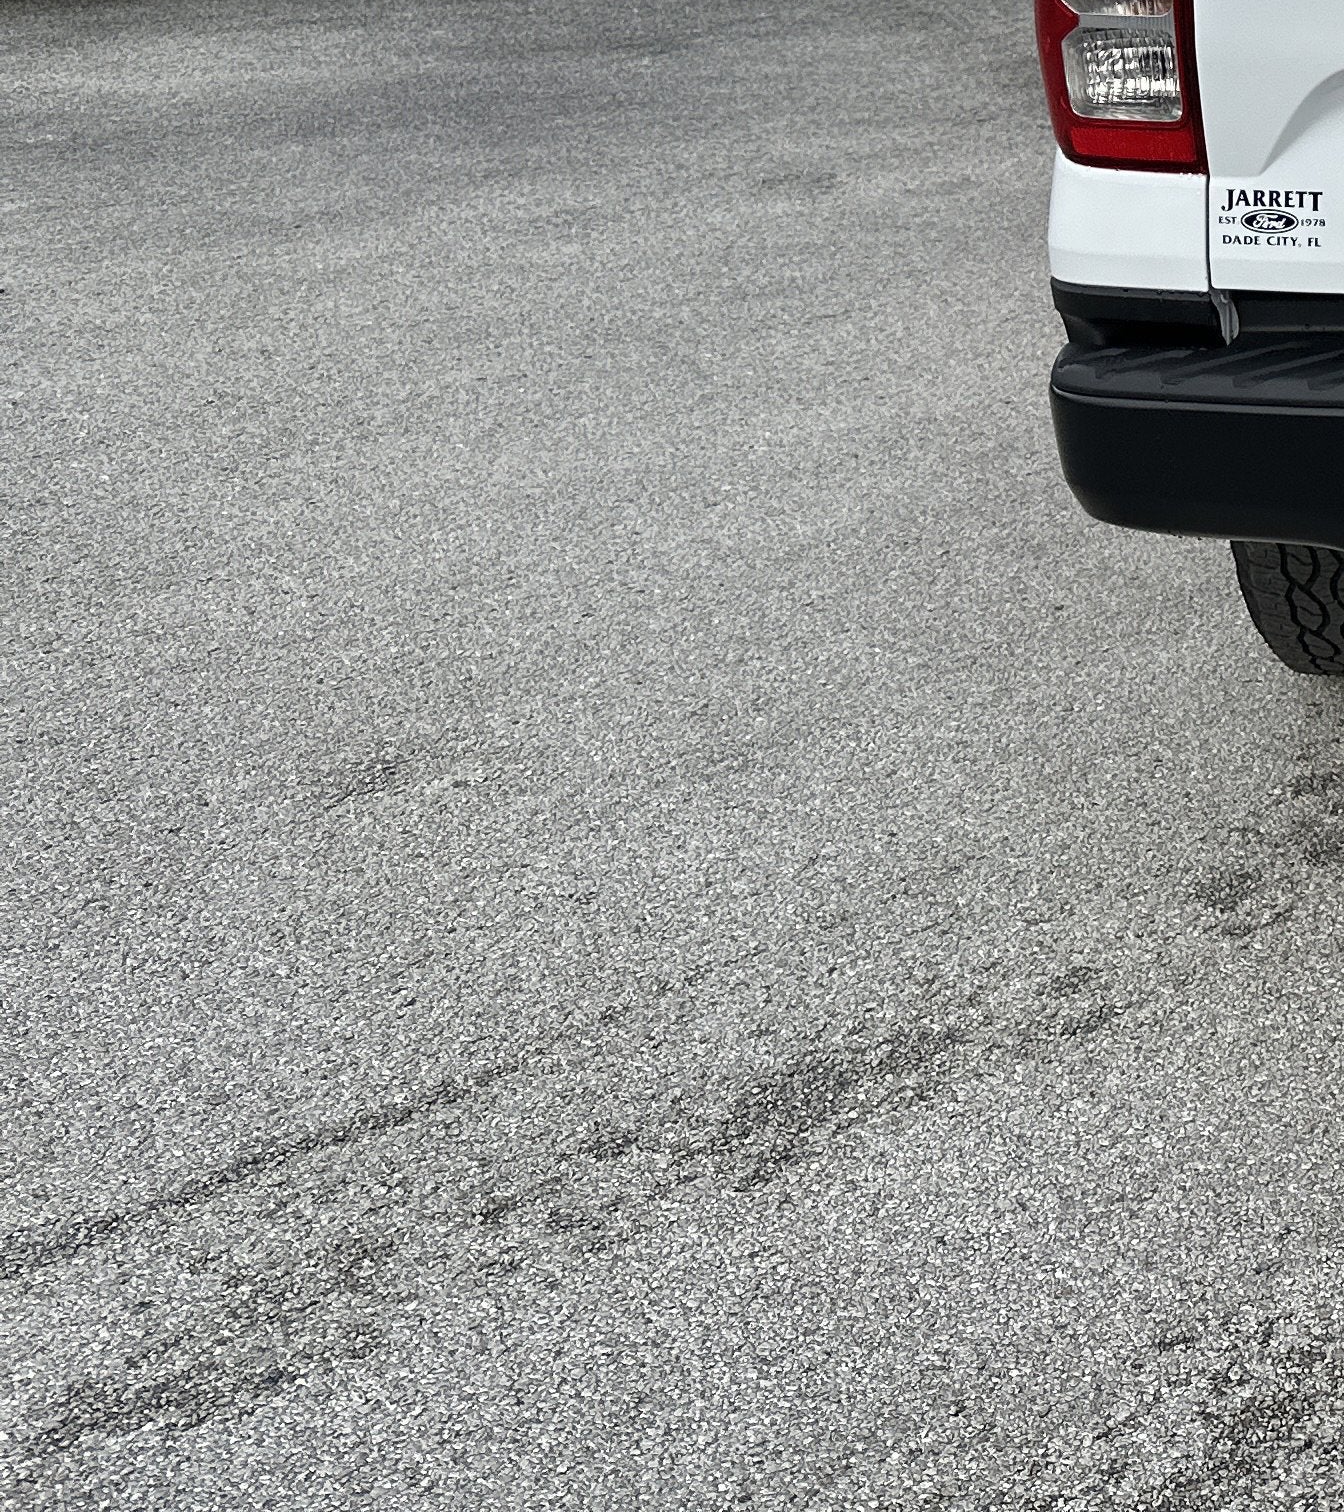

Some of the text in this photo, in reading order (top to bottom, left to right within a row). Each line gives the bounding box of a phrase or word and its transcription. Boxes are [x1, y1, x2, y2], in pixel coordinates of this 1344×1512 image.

[1220, 188, 1323, 212] JARRETT
[1252, 213, 1287, 229] Ford
[1300, 218, 1326, 227] 1978
[1222, 234, 1261, 245] DADE
[1307, 237, 1322, 247] FL
